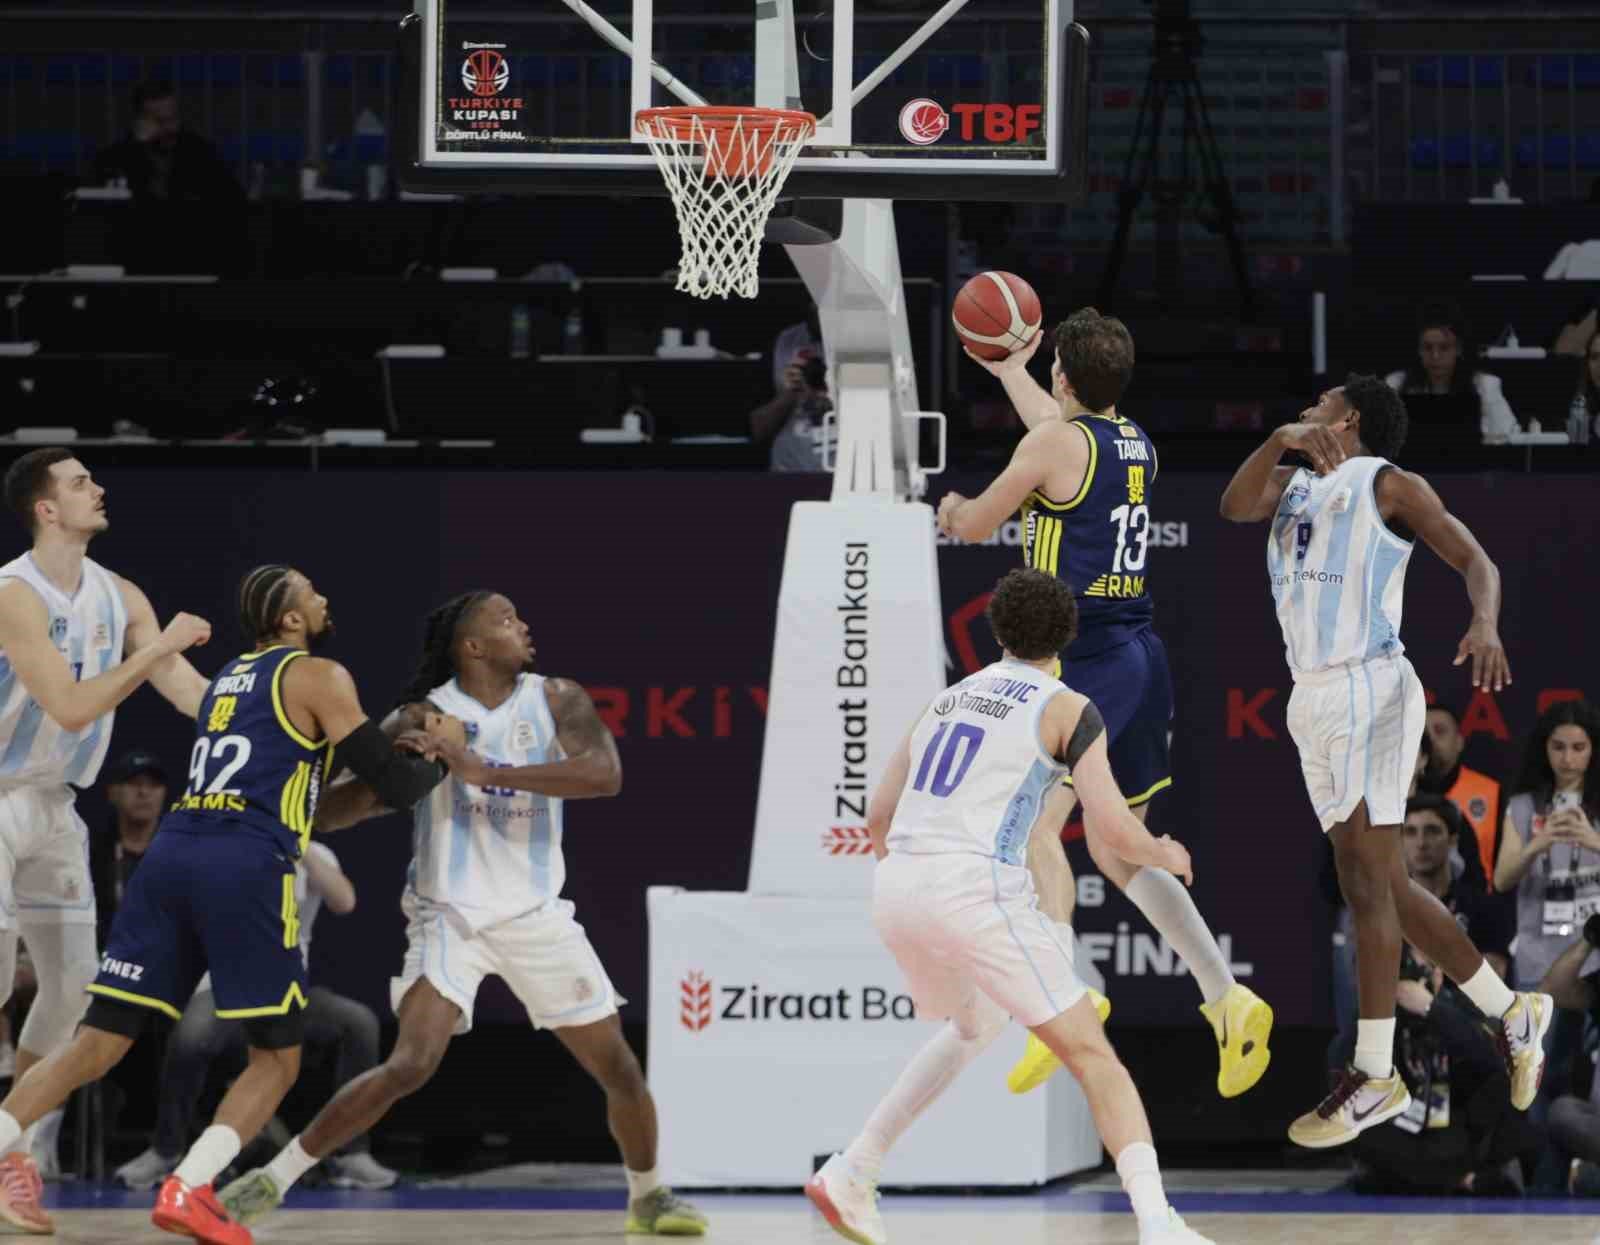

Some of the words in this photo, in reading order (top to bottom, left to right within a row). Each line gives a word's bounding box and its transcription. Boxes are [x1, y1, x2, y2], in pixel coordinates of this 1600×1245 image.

[453, 110, 517, 120] KUPASI
[952, 104, 1041, 143] TBF
[1110, 504, 1149, 573] 13
[836, 542, 868, 687] Bankası
[1108, 575, 1144, 597] RAM
[186, 734, 252, 797] 92
[835, 699, 867, 817] Ziraat
[912, 721, 985, 798] 10
[720, 985, 852, 1020] Ziraat
[861, 987, 916, 1020] Ba
